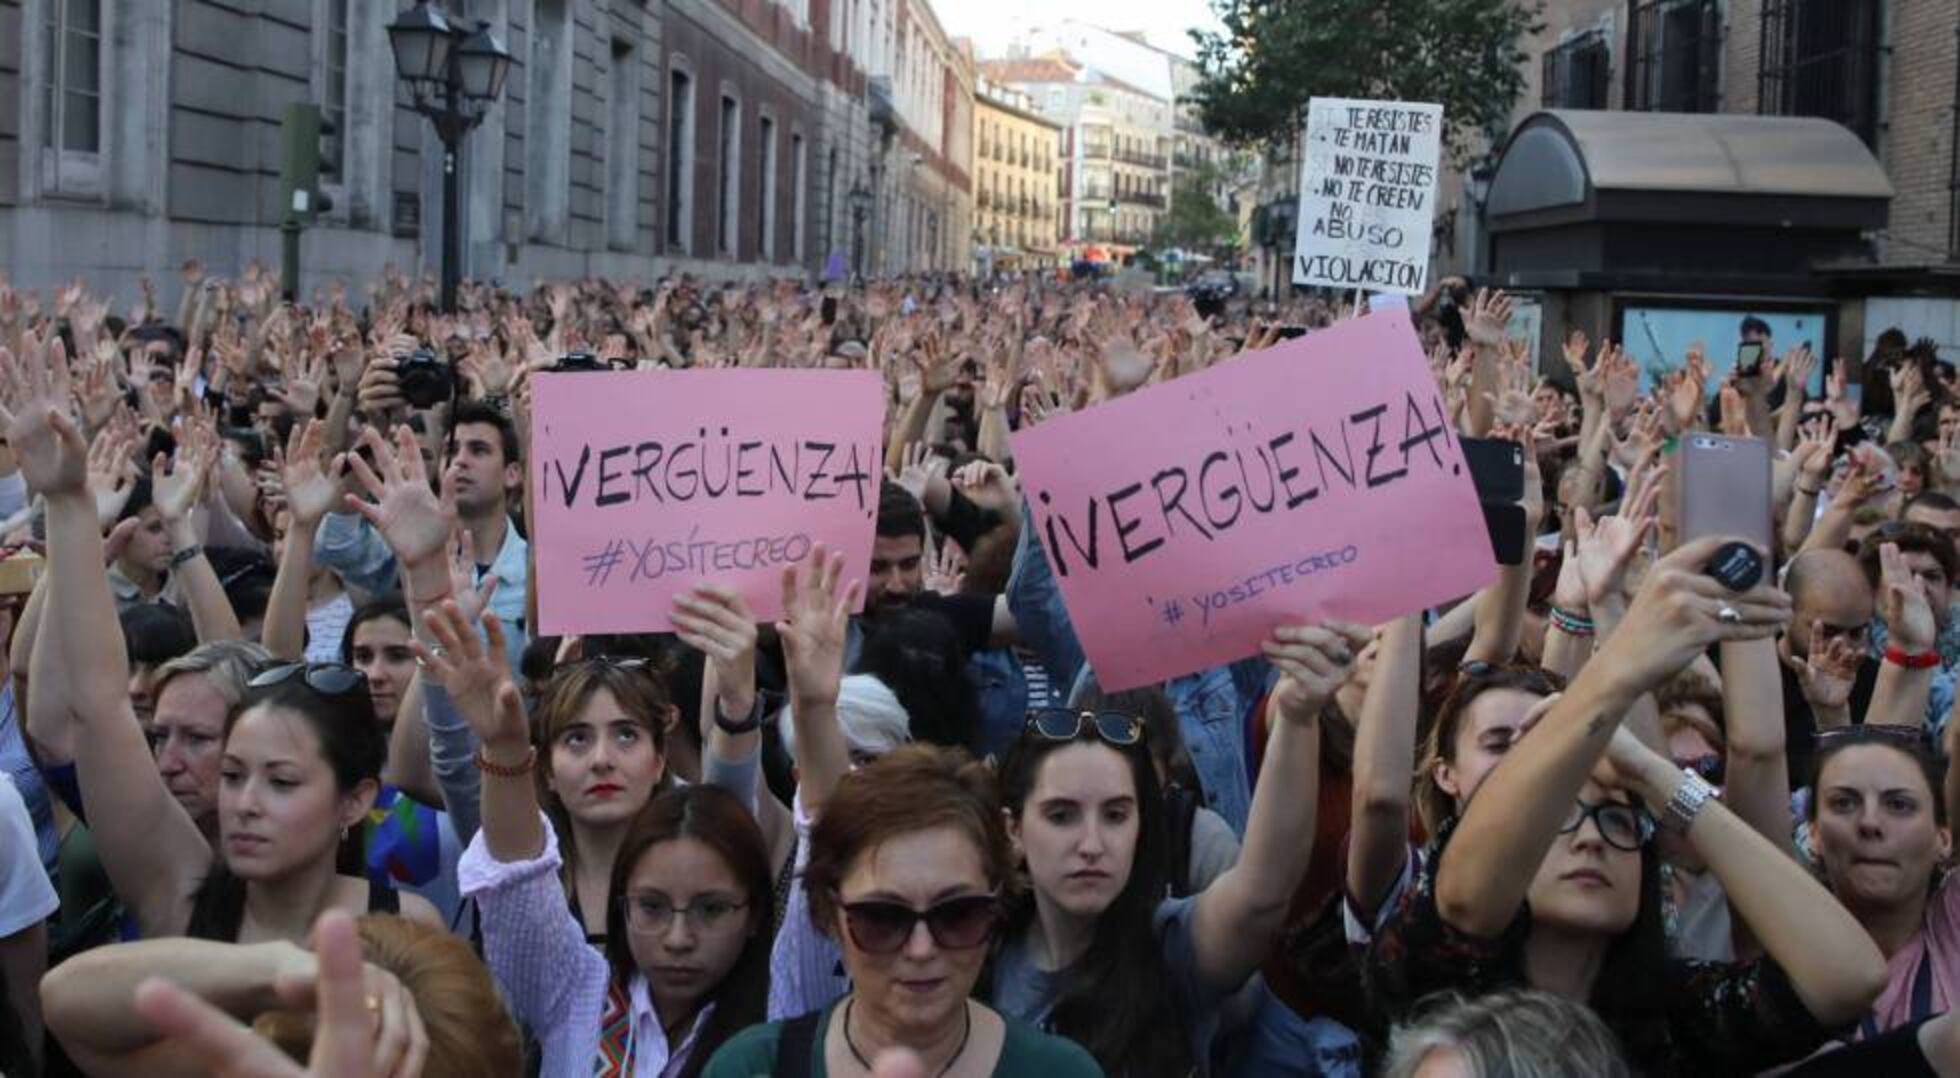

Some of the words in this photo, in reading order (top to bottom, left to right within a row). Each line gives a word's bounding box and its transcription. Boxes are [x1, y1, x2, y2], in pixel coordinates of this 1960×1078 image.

[1333, 127, 1351, 148] TE
[1353, 131, 1411, 155] MATAN
[1321, 177, 1343, 198] NO
[1347, 180, 1365, 203] TE
[1365, 183, 1425, 211] CREEN
[1330, 201, 1352, 221] NO
[1312, 217, 1404, 249] ABUSO
[1299, 255, 1424, 290] VIOLACIÓN
[543, 424, 876, 519] ¡VERGÜENZA!
[1037, 390, 1463, 578] ¡VERGÜENZA!
